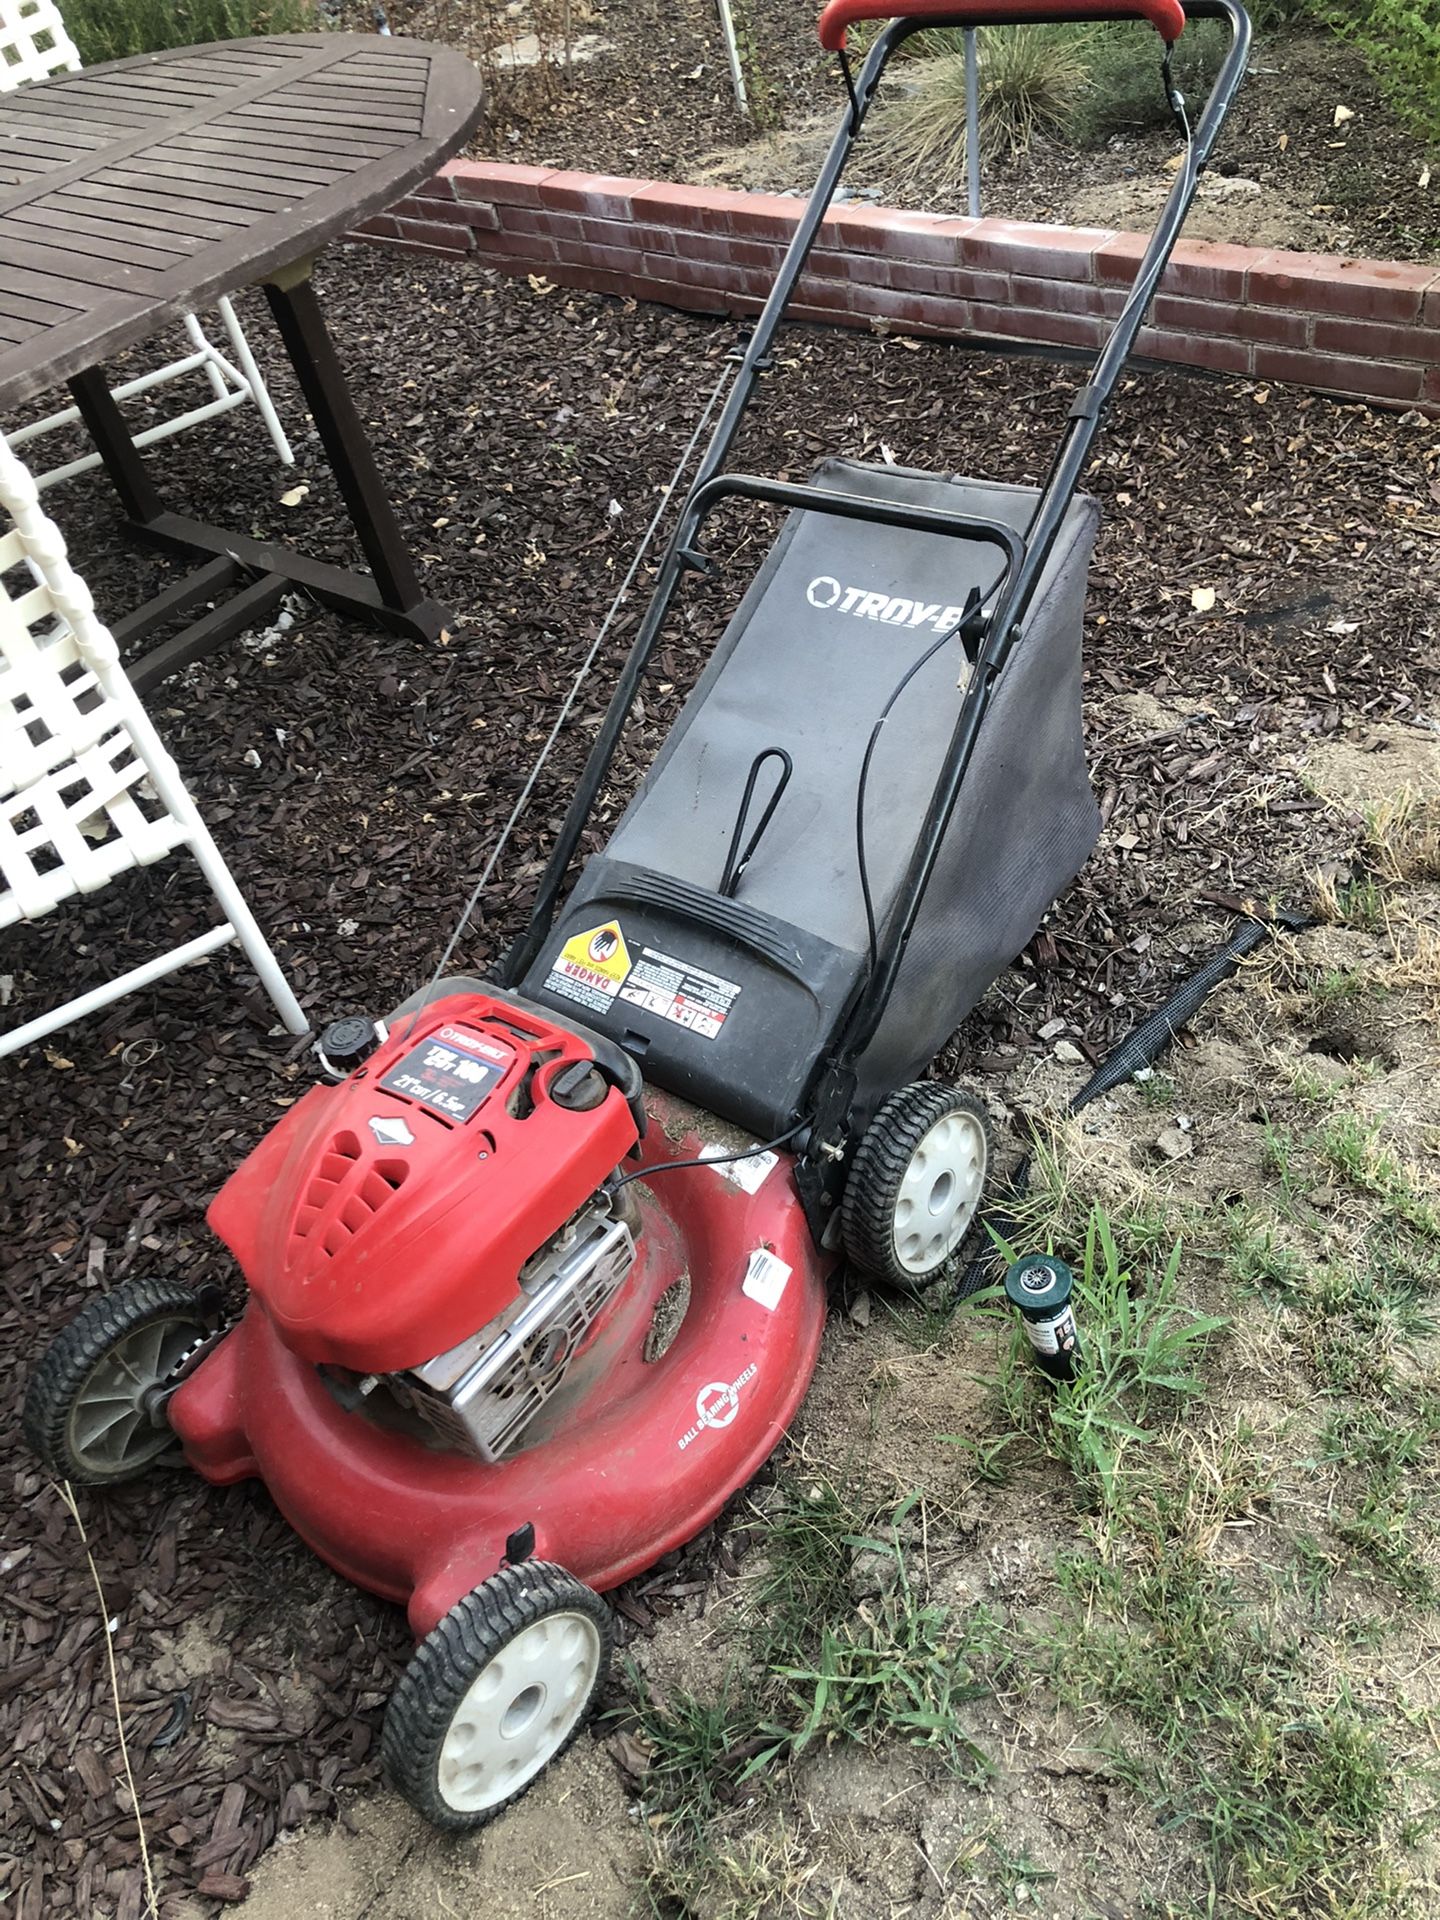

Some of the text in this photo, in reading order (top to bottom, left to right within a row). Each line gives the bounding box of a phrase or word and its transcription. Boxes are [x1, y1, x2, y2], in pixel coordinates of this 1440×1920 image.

[837, 586, 993, 633] TROY-B
[564, 962, 611, 990] DANGER
[452, 1058, 489, 1084] 100
[677, 1362, 758, 1450] BALL BEARING WHEELS
